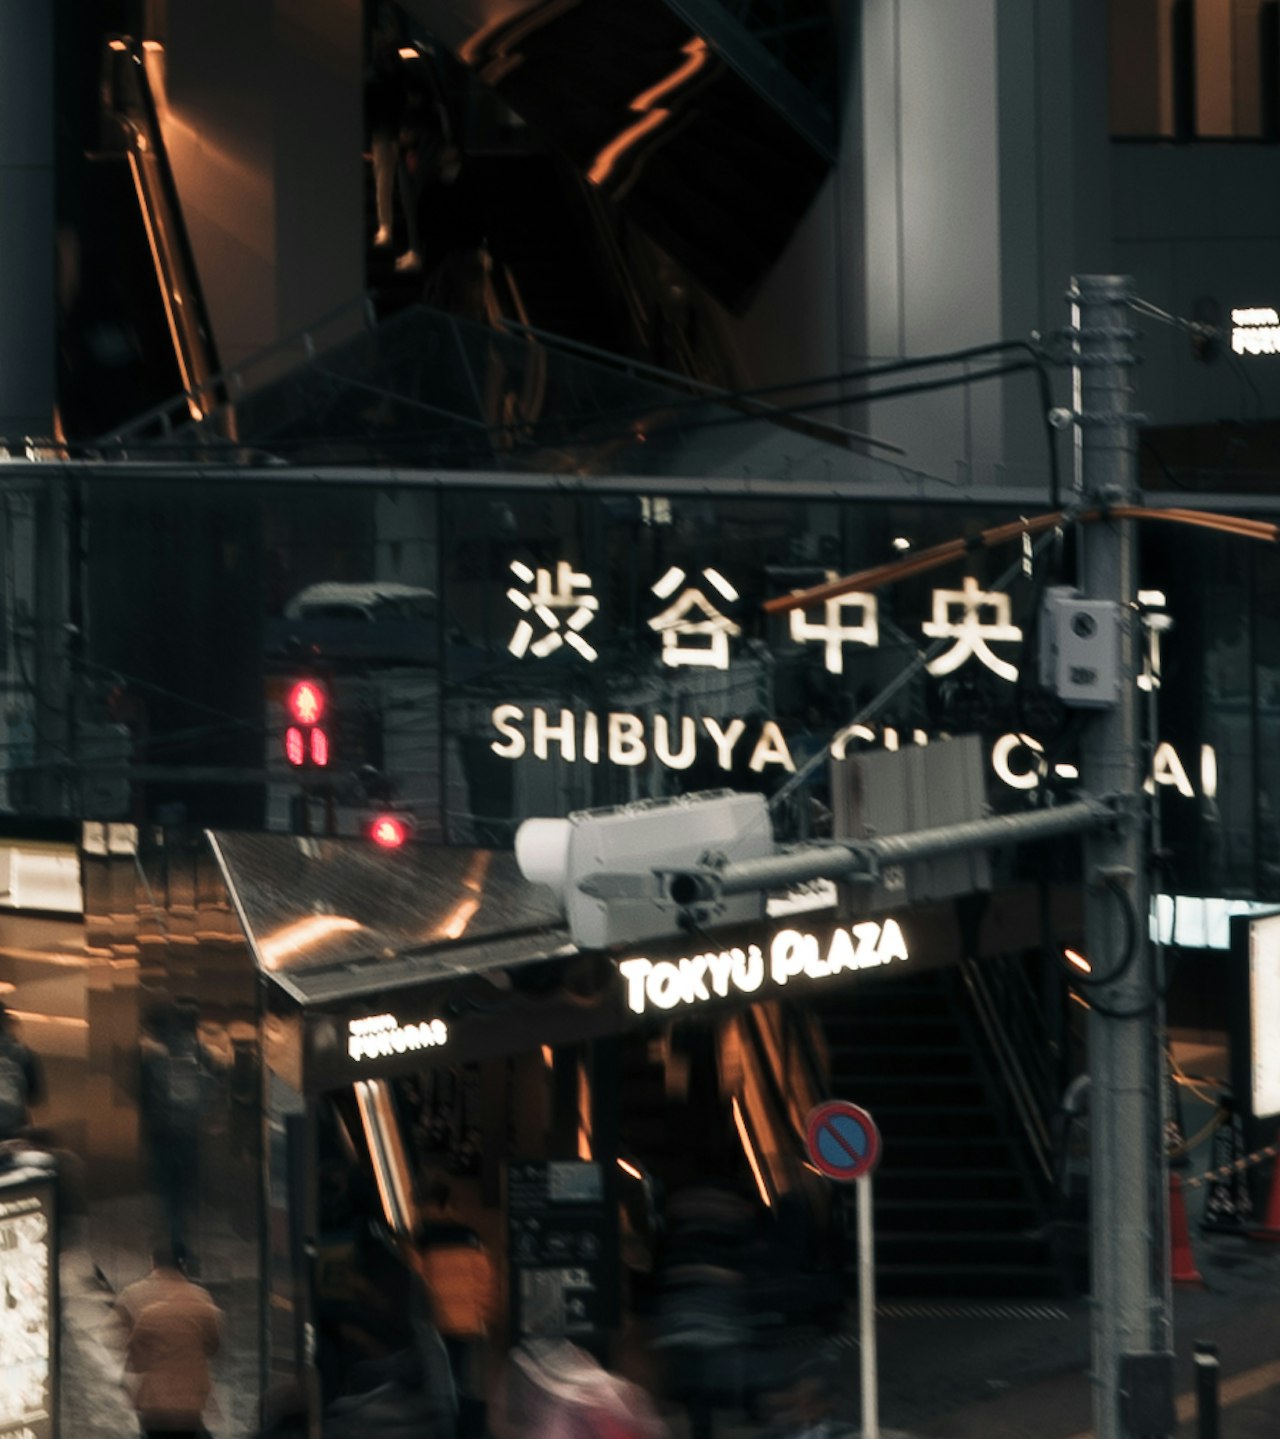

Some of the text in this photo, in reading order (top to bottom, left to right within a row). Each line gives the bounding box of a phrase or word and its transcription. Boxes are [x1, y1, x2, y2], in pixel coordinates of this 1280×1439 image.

[490, 703, 797, 773] SHIBUYA
[619, 918, 909, 1015] TOKYU PLAZA
